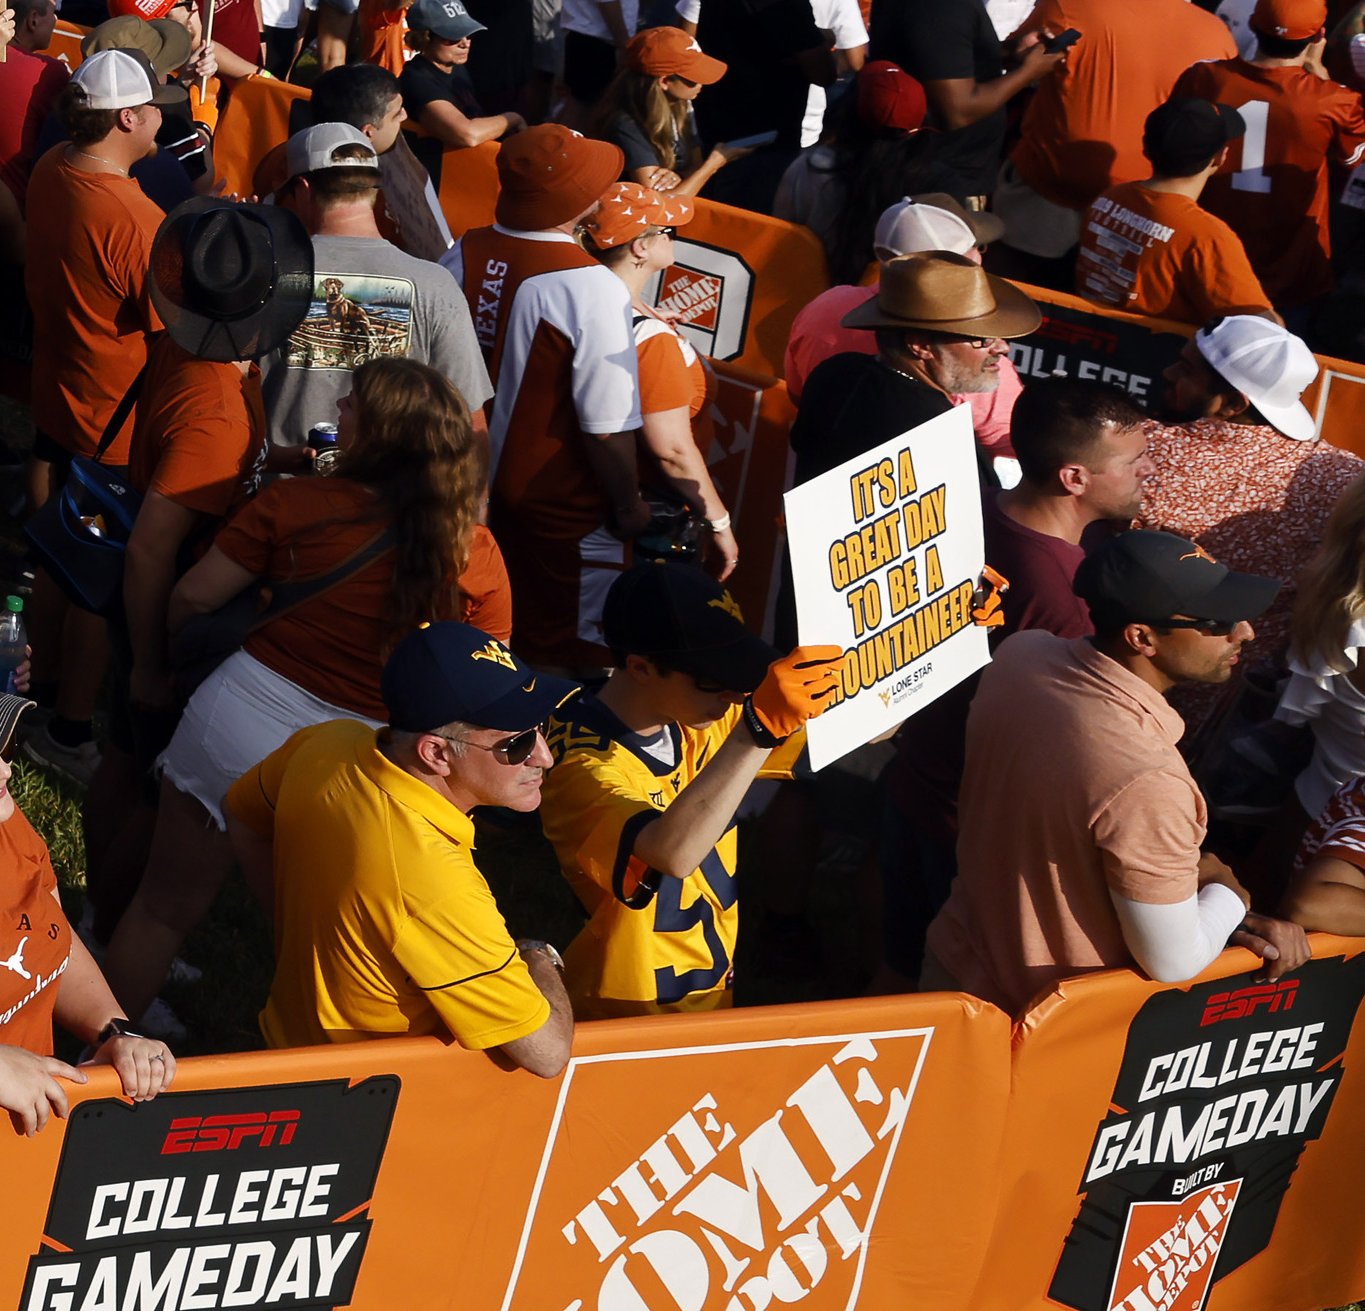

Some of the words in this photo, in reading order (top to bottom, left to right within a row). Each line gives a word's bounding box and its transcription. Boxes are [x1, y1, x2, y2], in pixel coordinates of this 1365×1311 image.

[1231, 99, 1272, 194] 1
[475, 258, 509, 349] TEXAS
[666, 275, 693, 294] THE
[851, 458, 895, 524] IT'S
[896, 448, 917, 498] A
[827, 509, 903, 591] GREAT
[905, 483, 946, 547] DAY
[847, 580, 883, 638] TO
[887, 556, 922, 617] BE
[922, 546, 945, 596] A
[891, 673, 913, 696] LONE
[913, 661, 934, 684] STAR
[1199, 979, 1301, 1027] ESPN
[1137, 1022, 1325, 1103] COLLEGE
[161, 1109, 301, 1157] ESPN
[1086, 1078, 1335, 1183] GAMEDAY
[86, 1163, 340, 1240] COLLEGE
[561, 1092, 738, 1263] THE
[565, 1036, 908, 1311] OME
[1172, 1168, 1203, 1196] BUILT
[1204, 1162, 1225, 1180] BY
[27, 1231, 361, 1311] GAMEDAY
[1132, 1214, 1187, 1275] THE
